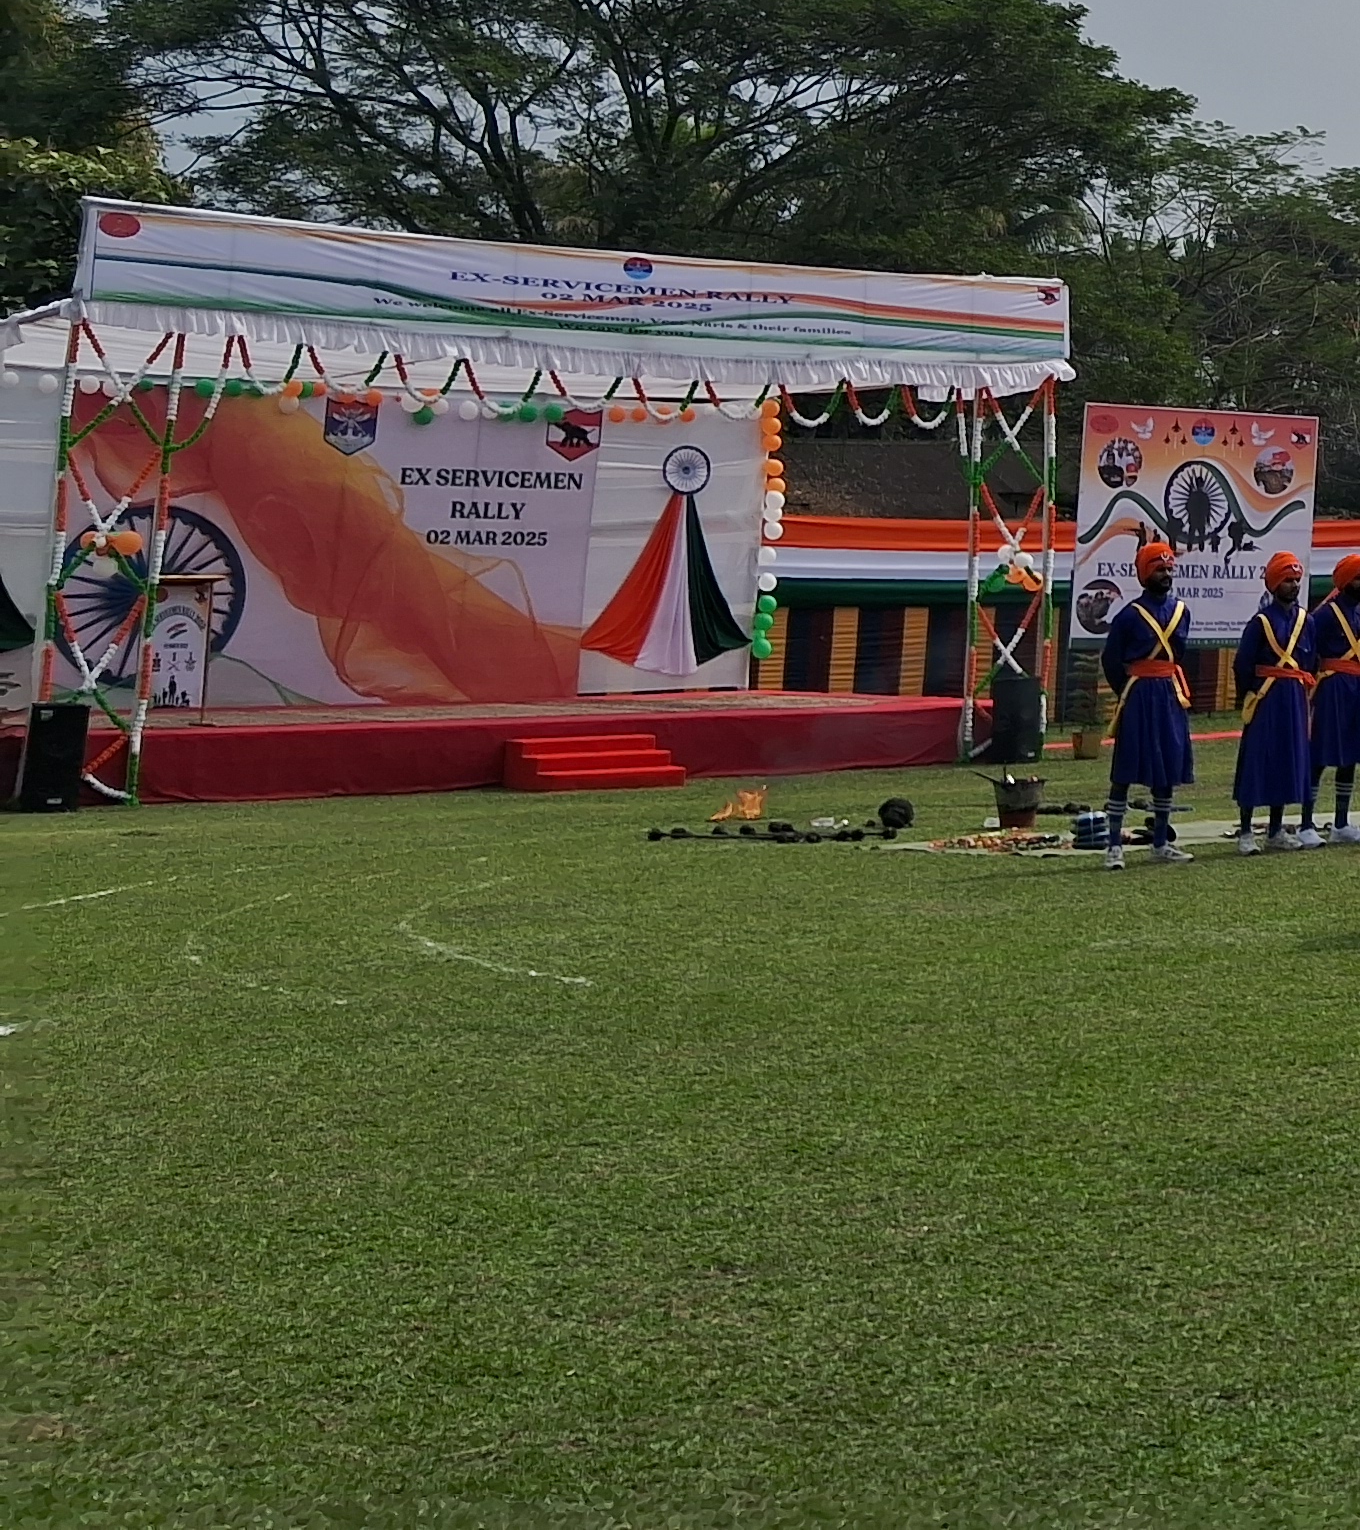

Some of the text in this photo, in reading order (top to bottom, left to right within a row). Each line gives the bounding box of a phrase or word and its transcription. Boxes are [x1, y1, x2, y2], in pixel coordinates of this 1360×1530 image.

[450, 271, 795, 305] EX-SERVICEMEN RALLY
[541, 292, 713, 312] 02 MAR 2025
[400, 468, 583, 490] EX SERVICEMEN
[450, 501, 526, 520] RALLY
[426, 530, 548, 547] 02 MAR 2025
[1212, 565, 1256, 580] RALLY
[1176, 587, 1200, 599] MAR
[1201, 588, 1224, 599] 2025
